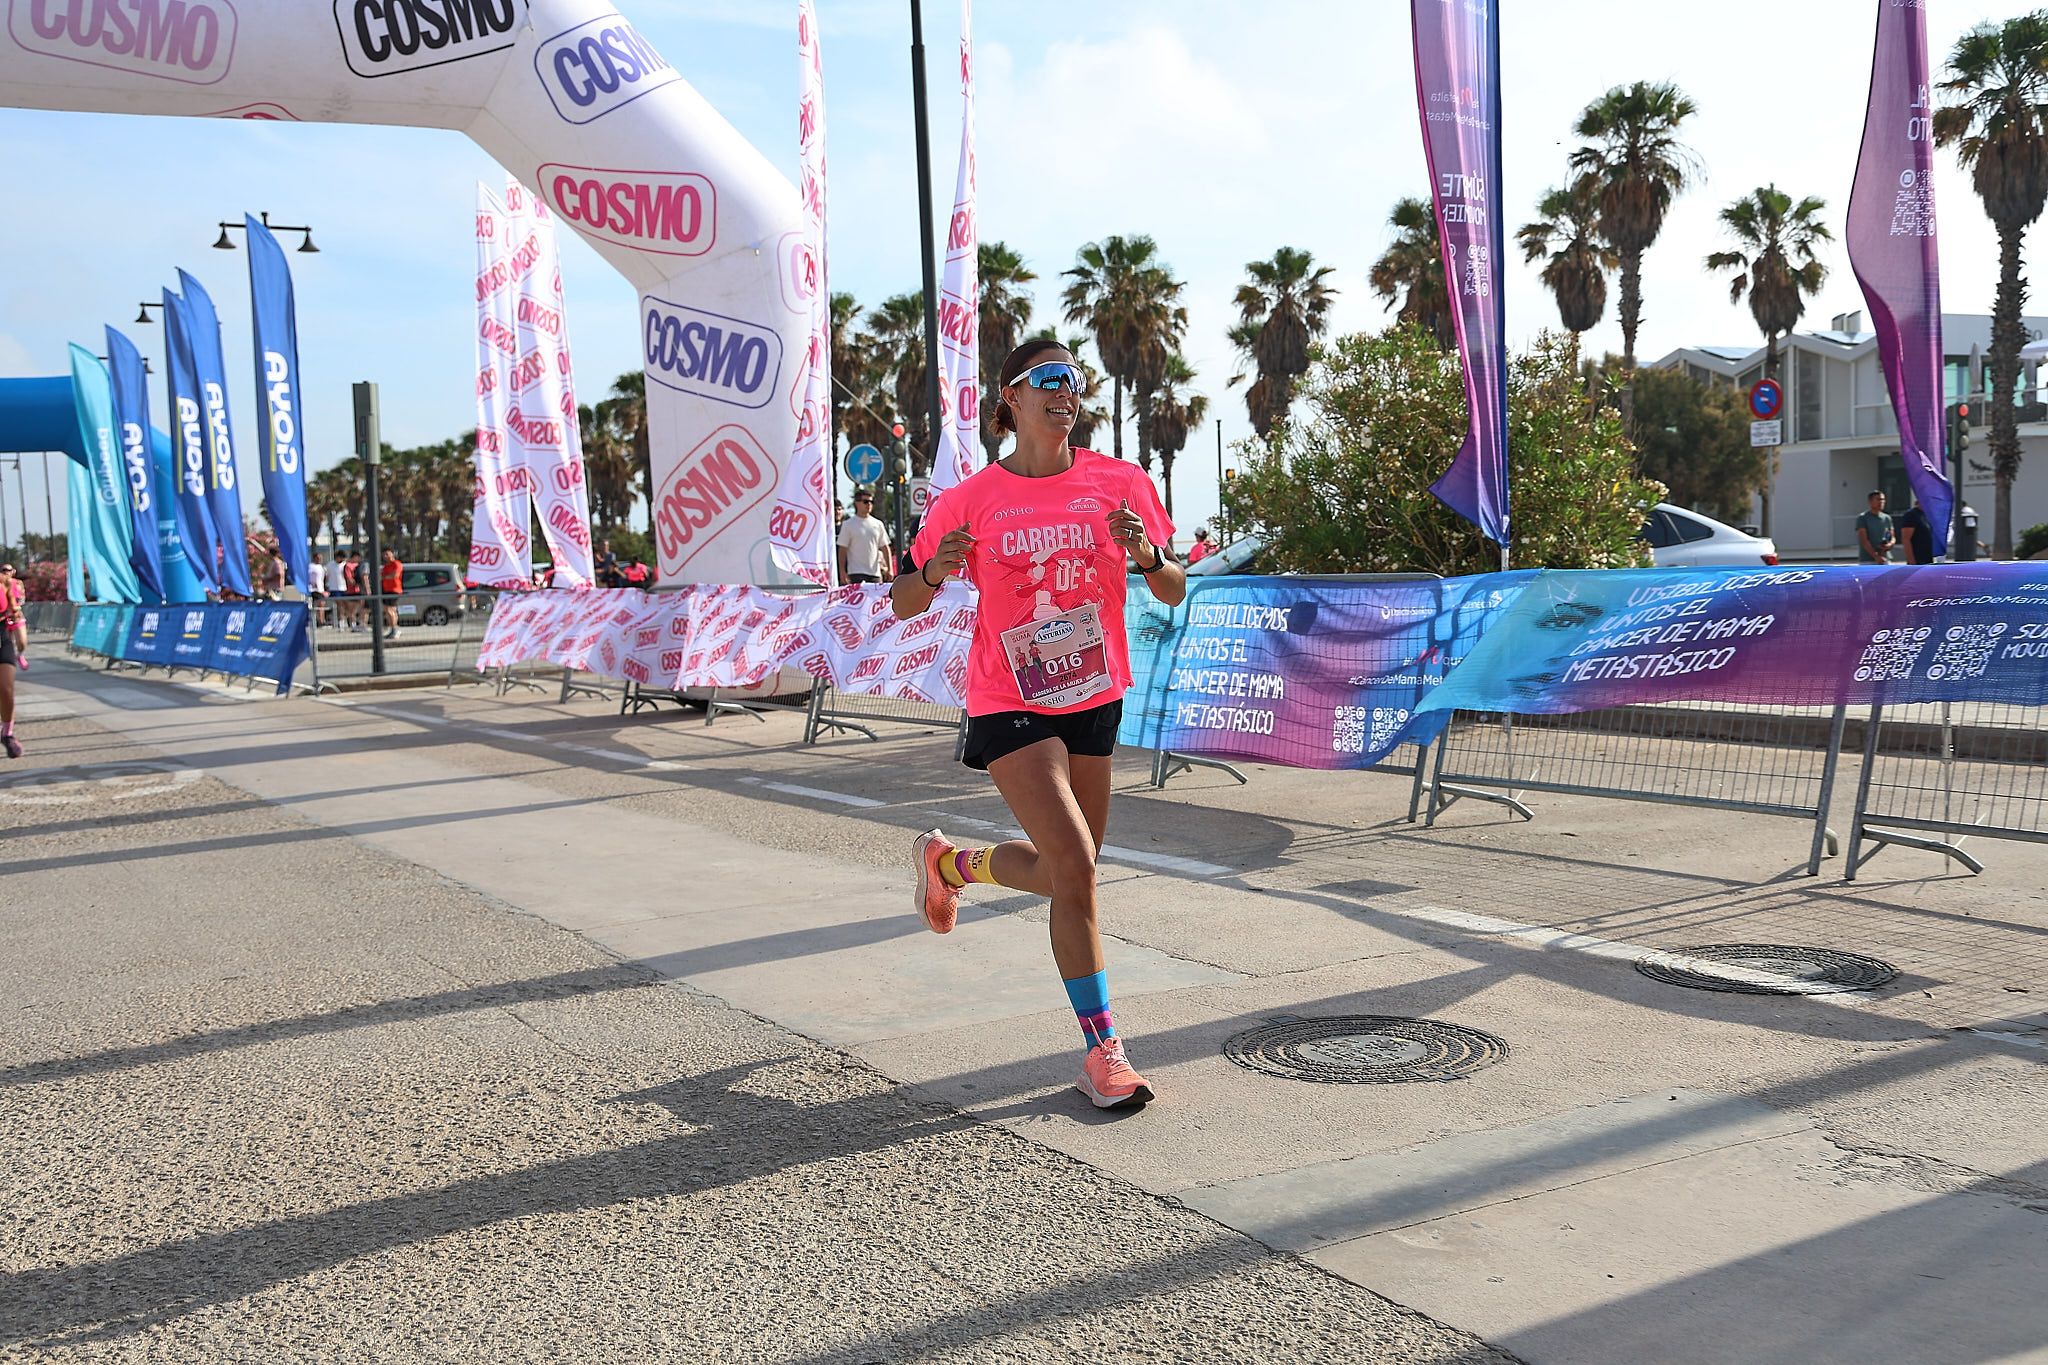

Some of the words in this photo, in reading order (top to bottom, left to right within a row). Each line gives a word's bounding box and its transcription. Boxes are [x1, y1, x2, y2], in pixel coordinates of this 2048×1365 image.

[554, 26, 670, 106] COSM
[553, 175, 702, 243] COSMO
[646, 309, 768, 393] COSMO
[657, 439, 761, 559] COSMO
[994, 507, 1034, 521] OYSHO
[1002, 523, 1096, 556] CARRERA
[1627, 569, 1825, 608] VISIBILICEMOS
[901, 610, 944, 641] COSMO
[949, 608, 977, 634] COSM
[1189, 605, 1292, 632] VISIBILICEMOS
[1588, 601, 1680, 634] JUNTOS
[1680, 597, 1713, 616] EL
[1656, 620, 1701, 645] DE
[1693, 614, 1776, 641] MAMA
[1037, 626, 1073, 642] ASTURIANA
[1231, 638, 1248, 662] EL
[896, 644, 939, 675] COSMO
[1045, 652, 1084, 675] 016
[1561, 646, 1736, 683] METASTÁSICO
[1169, 663, 1228, 695] CÁNCER
[1229, 672, 1248, 697] DE
[1248, 673, 1284, 699] MAMA
[1175, 701, 1275, 735] METASTÁSICO
